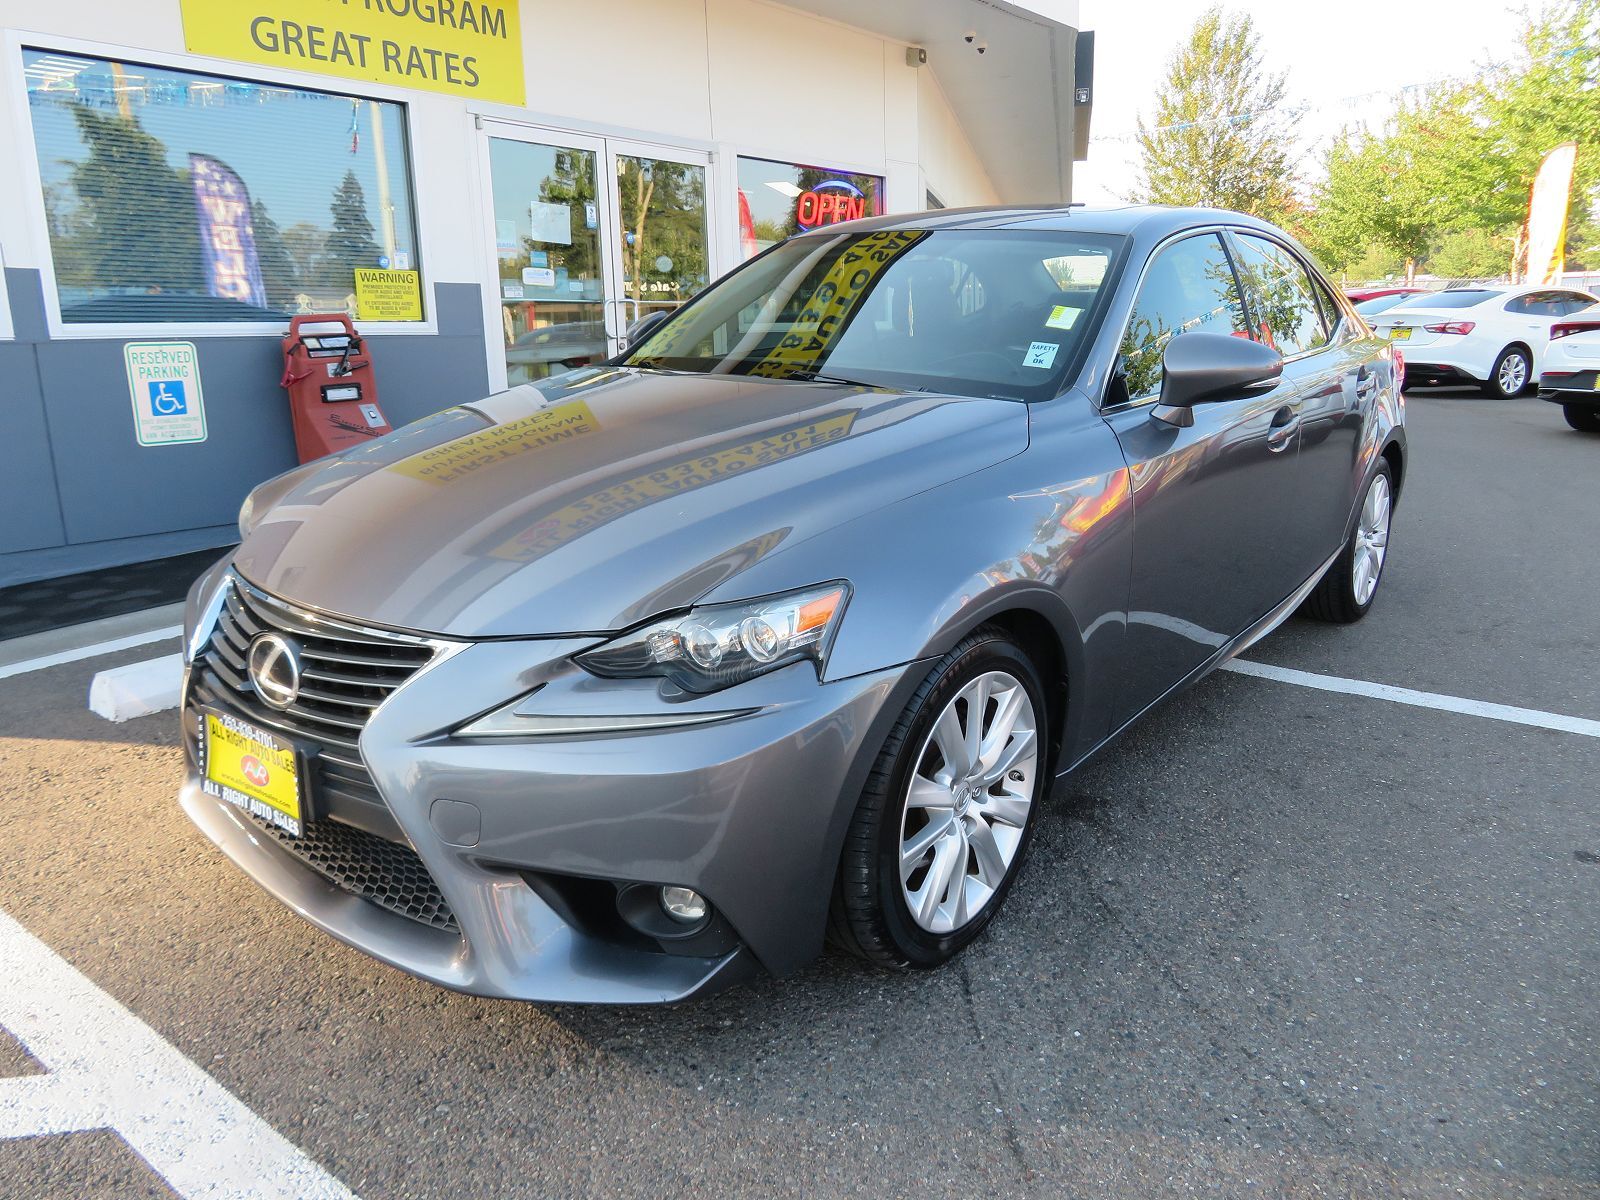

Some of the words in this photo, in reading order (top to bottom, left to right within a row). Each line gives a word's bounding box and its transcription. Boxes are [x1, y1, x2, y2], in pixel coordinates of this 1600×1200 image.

[341, 0, 507, 39] OGRAM
[250, 16, 371, 68] GREAT
[382, 40, 480, 87] RATES
[799, 191, 865, 226] OPEN
[360, 272, 414, 283] WARNING
[131, 351, 191, 364] RESERVED
[139, 365, 189, 378] PARKING
[212, 723, 224, 740] ALL
[226, 729, 247, 751] RIGHT
[250, 739, 270, 761] AUTO
[272, 751, 295, 774] SALES
[203, 780, 220, 797] ALL
[222, 786, 249, 809] RIGHT
[250, 799, 272, 820] AUTO
[273, 810, 299, 836] SALES
